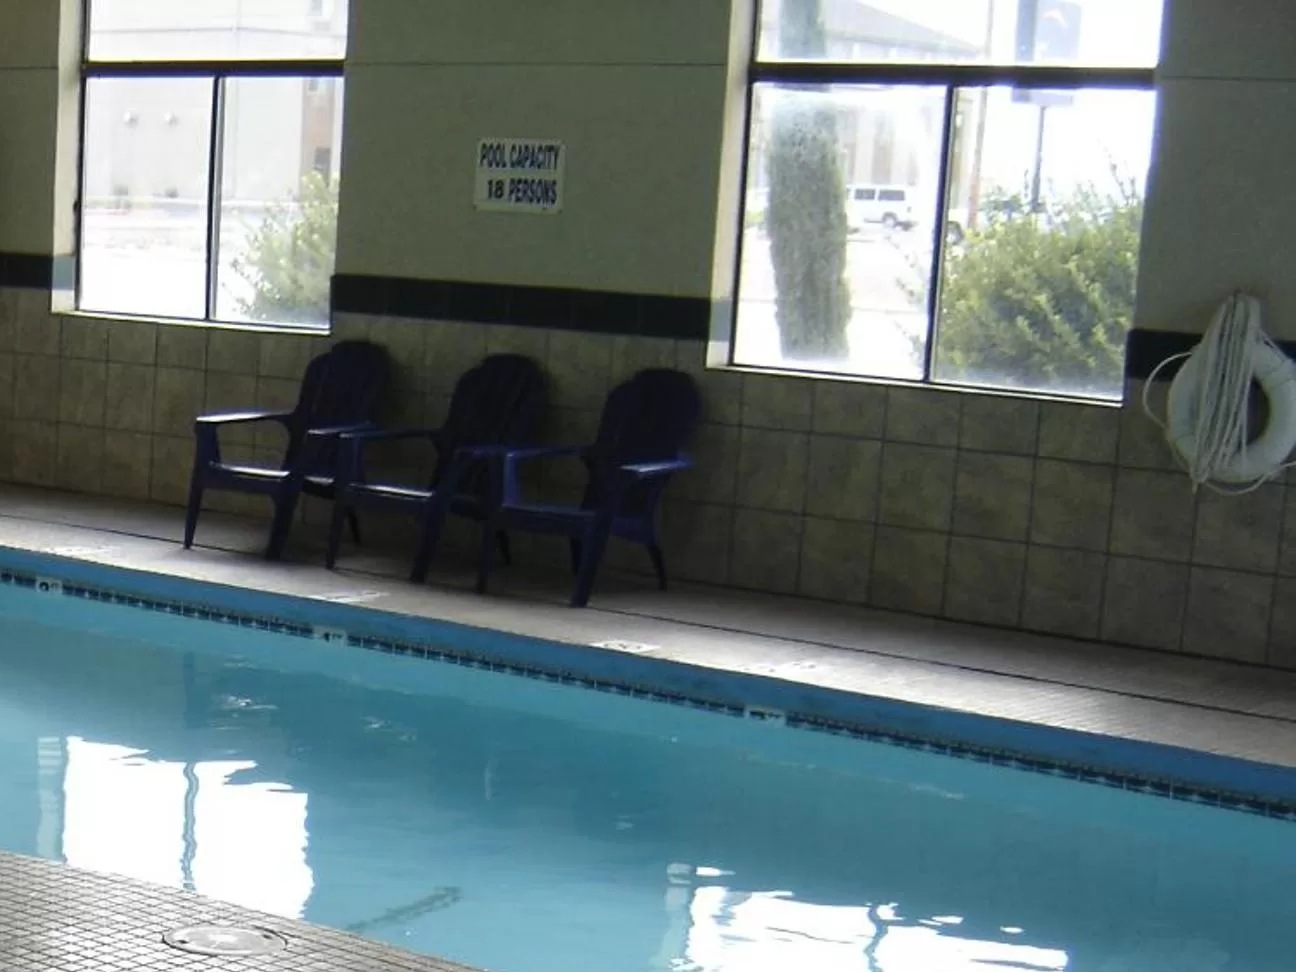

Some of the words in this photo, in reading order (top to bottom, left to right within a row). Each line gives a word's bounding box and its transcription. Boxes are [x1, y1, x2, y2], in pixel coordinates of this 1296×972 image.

[480, 143, 507, 168] POOL
[509, 143, 561, 170] CAPACITY
[487, 179, 505, 199] 18
[508, 178, 557, 204] PERSONS
